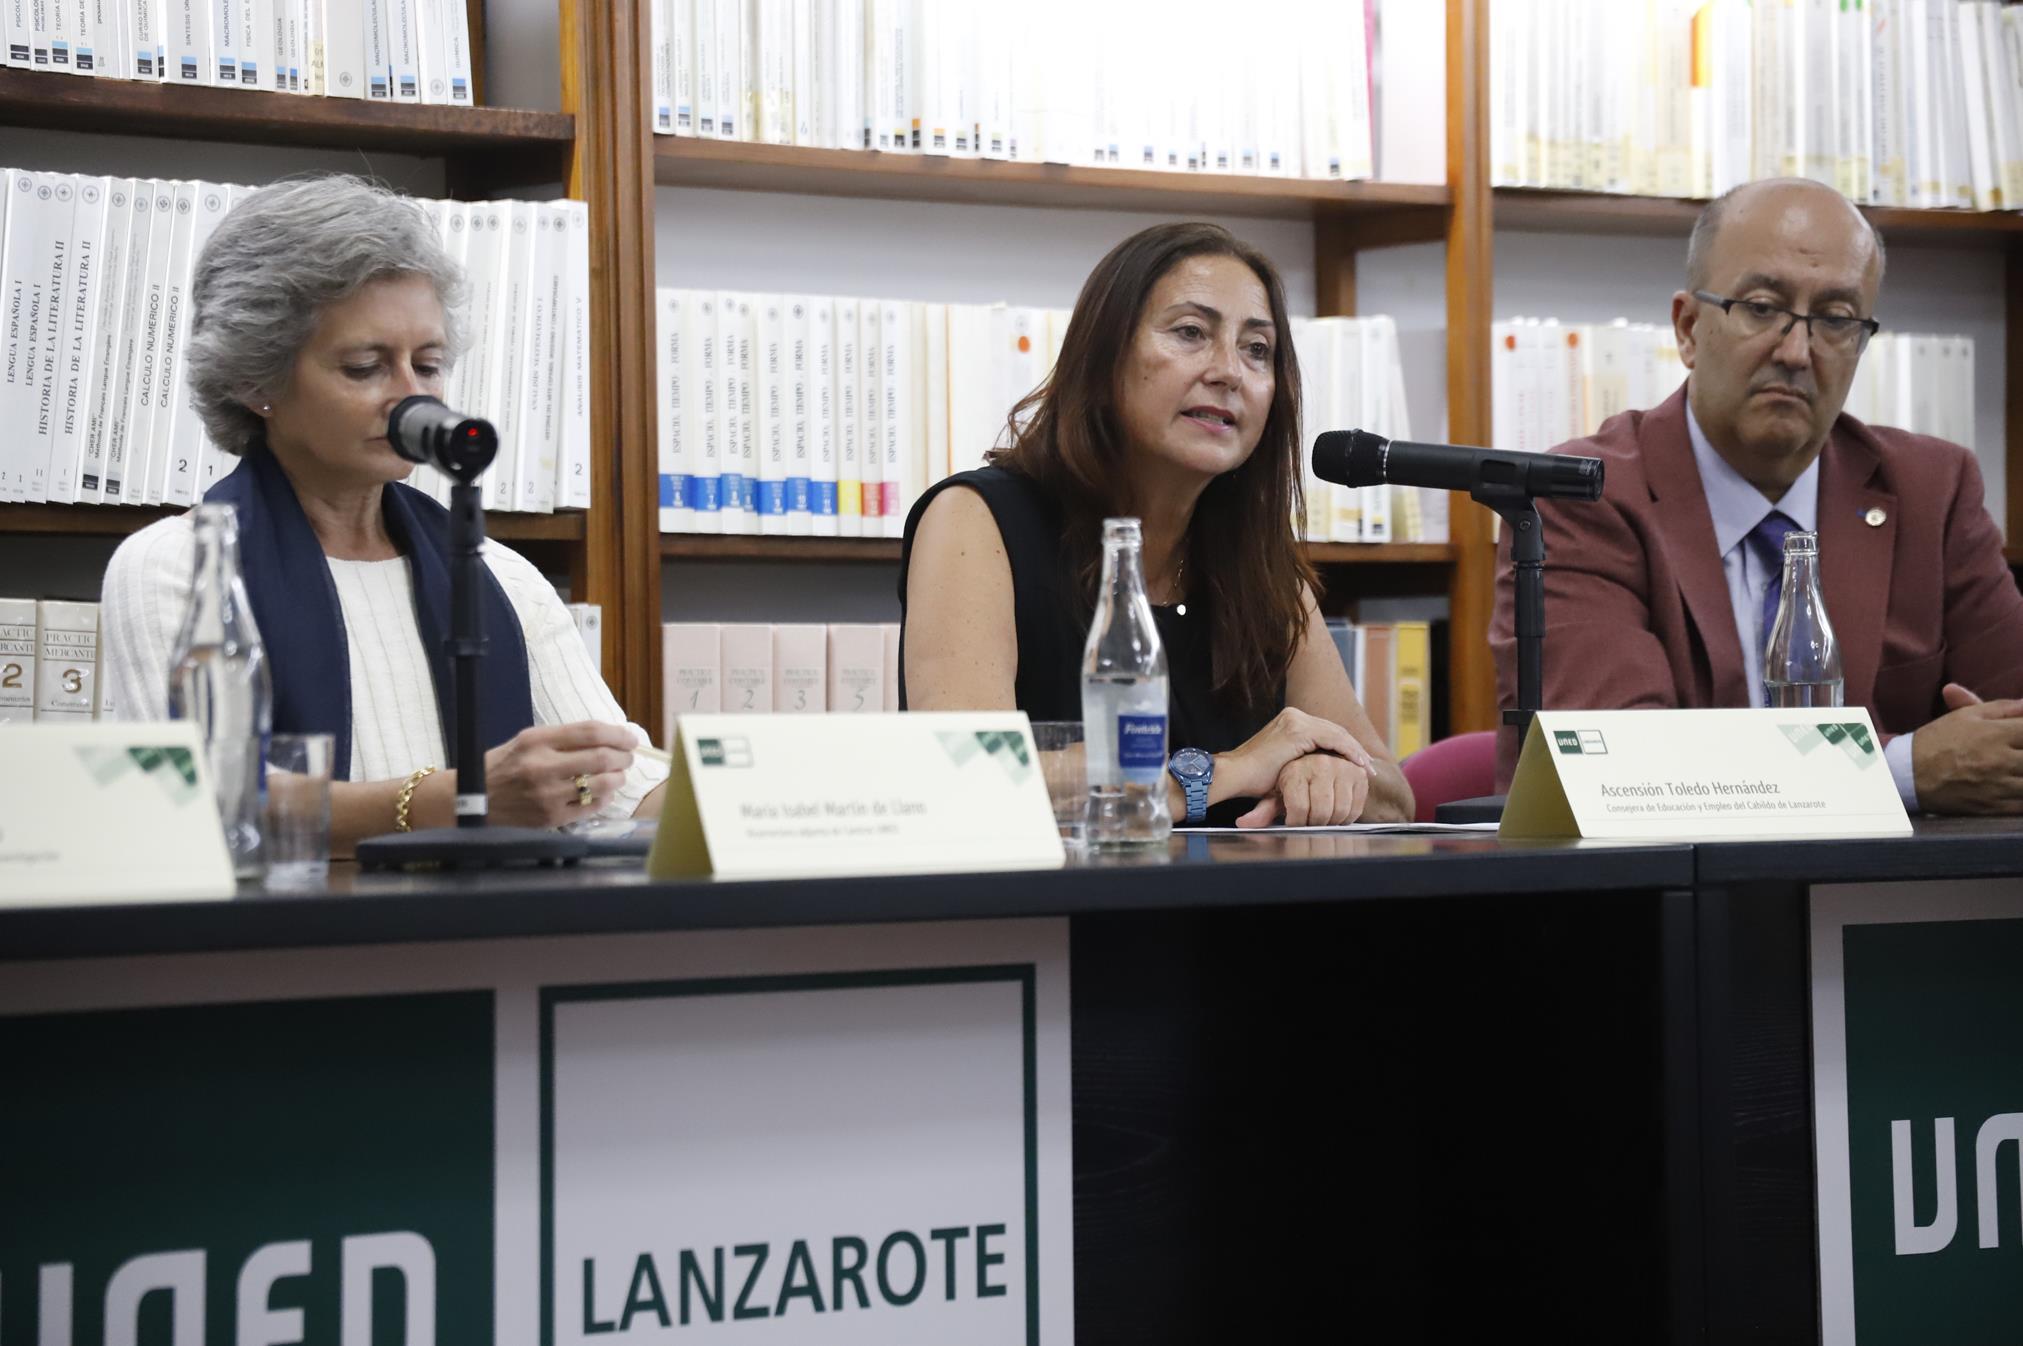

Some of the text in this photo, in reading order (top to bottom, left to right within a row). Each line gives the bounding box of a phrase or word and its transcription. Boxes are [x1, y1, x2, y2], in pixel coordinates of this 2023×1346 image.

[47, 254, 64, 333] LITERATURA
[74, 253, 90, 333] LITERATURA
[11, 287, 22, 340] ESPAÑOLA
[29, 291, 41, 343] ESPAÑOLA
[146, 293, 159, 352] NUMERICO
[46, 336, 56, 353] LA
[72, 335, 83, 352] LA
[160, 356, 172, 408] CALCULO
[166, 295, 179, 354] NUMERICO
[7, 342, 17, 384] LENGUA
[25, 346, 36, 387] LENGUA
[44, 354, 55, 373] DE
[71, 354, 81, 373] DE
[141, 354, 153, 406] CALCULO
[38, 375, 52, 436] HISTORIA
[64, 375, 78, 435] HISTORIA
[178, 459, 188, 472] 2
[207, 465, 213, 477] 1
[575, 463, 583, 476] 2
[2, 663, 23, 688] 2
[62, 668, 82, 694] 3
[743, 689, 755, 709] 2
[794, 689, 806, 711] 3
[855, 687, 865, 711] 5
[1601, 780, 1781, 797] Ascensión Toledo Hernández
[1606, 803, 1645, 814] Consejera
[1646, 803, 1656, 812] de
[1657, 802, 1697, 812] Educación
[1704, 802, 1733, 812] Empleo
[1733, 801, 1746, 811] del
[1747, 800, 1776, 810] Cabildo
[1777, 800, 1787, 810] de
[1788, 799, 1826, 809] Lanzarote
[582, 1223, 1007, 1336] LANZAROTE
